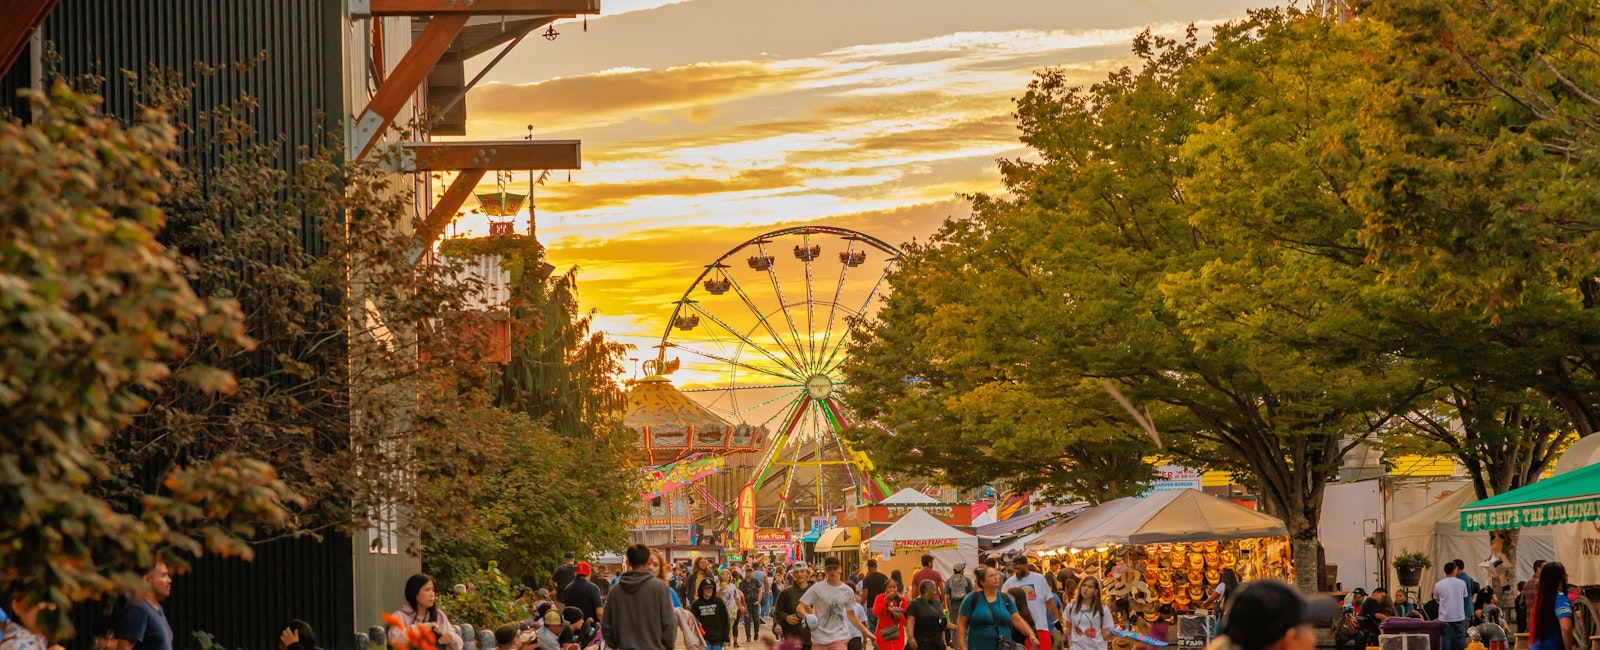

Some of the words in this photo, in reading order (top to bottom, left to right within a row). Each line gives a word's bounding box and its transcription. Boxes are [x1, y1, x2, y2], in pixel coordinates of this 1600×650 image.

[739, 486, 754, 548] ATM
[1466, 513, 1486, 527] COW
[1490, 510, 1518, 525] CHIPS
[1522, 508, 1544, 522] THE
